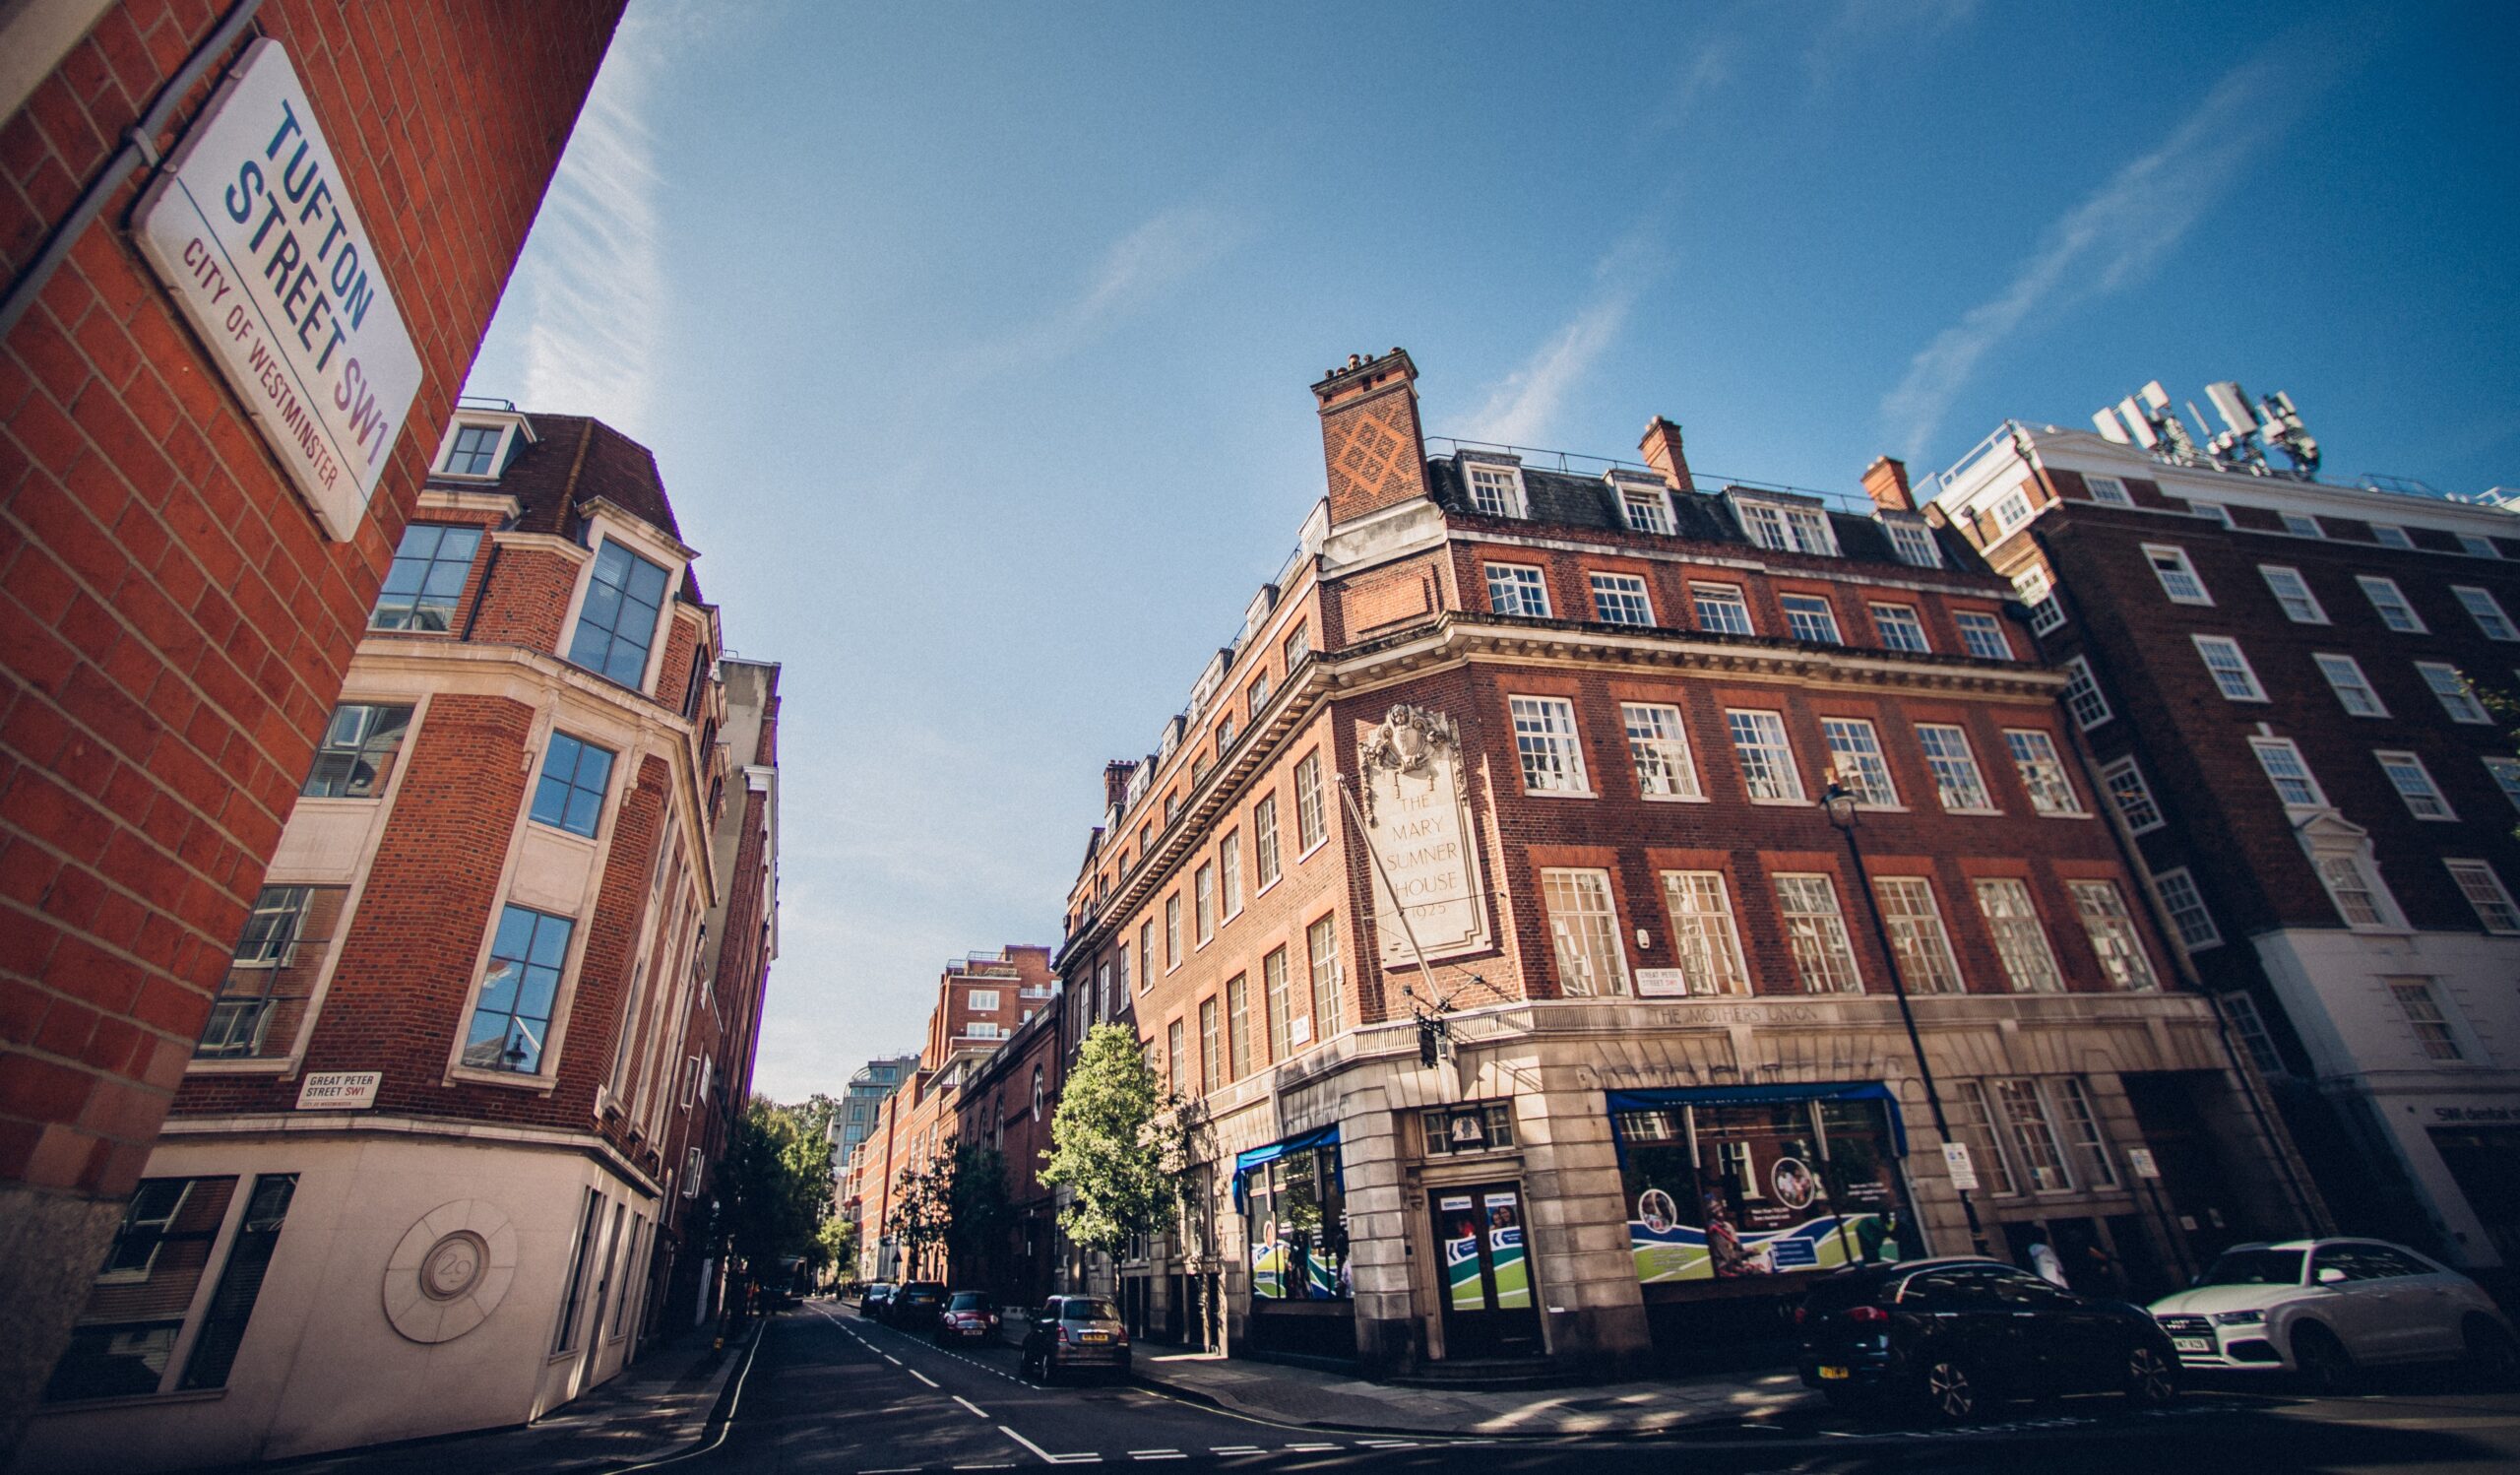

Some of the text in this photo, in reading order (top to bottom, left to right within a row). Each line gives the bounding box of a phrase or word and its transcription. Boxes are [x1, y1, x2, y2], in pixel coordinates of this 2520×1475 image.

[266, 99, 374, 333] TUFTON
[225, 160, 389, 466] STREET SW1
[183, 237, 339, 492] CITY OF WESTMINSTER
[1400, 795, 1429, 811] THE
[1392, 815, 1443, 842] MARY
[1386, 842, 1458, 871] SUMNER
[1395, 871, 1458, 897] HOUSE
[1412, 904, 1446, 921] 1925
[1653, 1008, 1681, 1024] THE
[1767, 1005, 1818, 1021] UNION
[306, 1087, 343, 1097] STREET
[309, 1075, 374, 1086] GREAT PETER
[438, 1252, 472, 1283] 29
